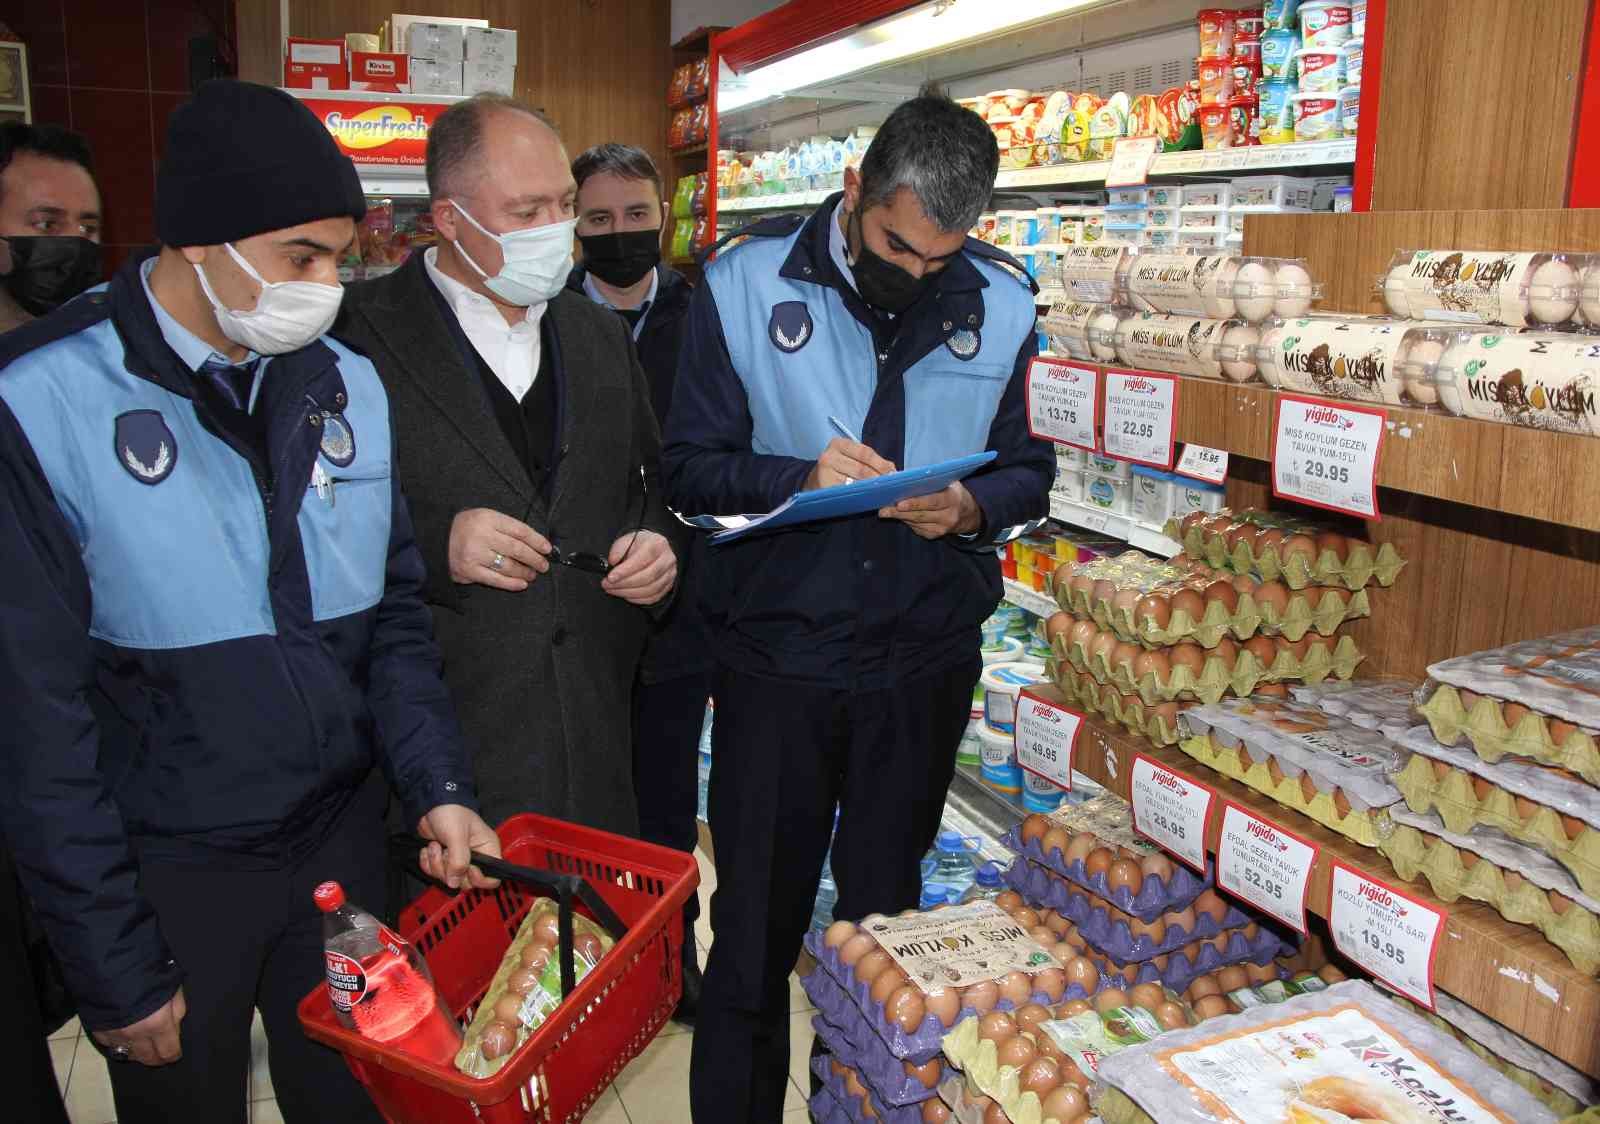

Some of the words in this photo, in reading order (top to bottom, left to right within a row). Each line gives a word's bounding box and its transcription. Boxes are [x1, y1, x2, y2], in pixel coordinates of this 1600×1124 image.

[325, 112, 428, 142] SuperFresh
[1047, 405, 1077, 425] 13.75
[1123, 420, 1153, 439] 22.95
[1291, 441, 1317, 455] TAVUK
[1340, 437, 1368, 452] GEZEN
[1304, 459, 1349, 483] 29.95
[1032, 742, 1057, 762] 49.95
[1153, 812, 1185, 839] 28.95
[1250, 844, 1274, 863] GEZEN
[1275, 857, 1299, 877] TAVUK
[1244, 866, 1283, 900] 52.95
[1365, 903, 1404, 931] YUMURTA
[1361, 928, 1406, 965] 19.95
